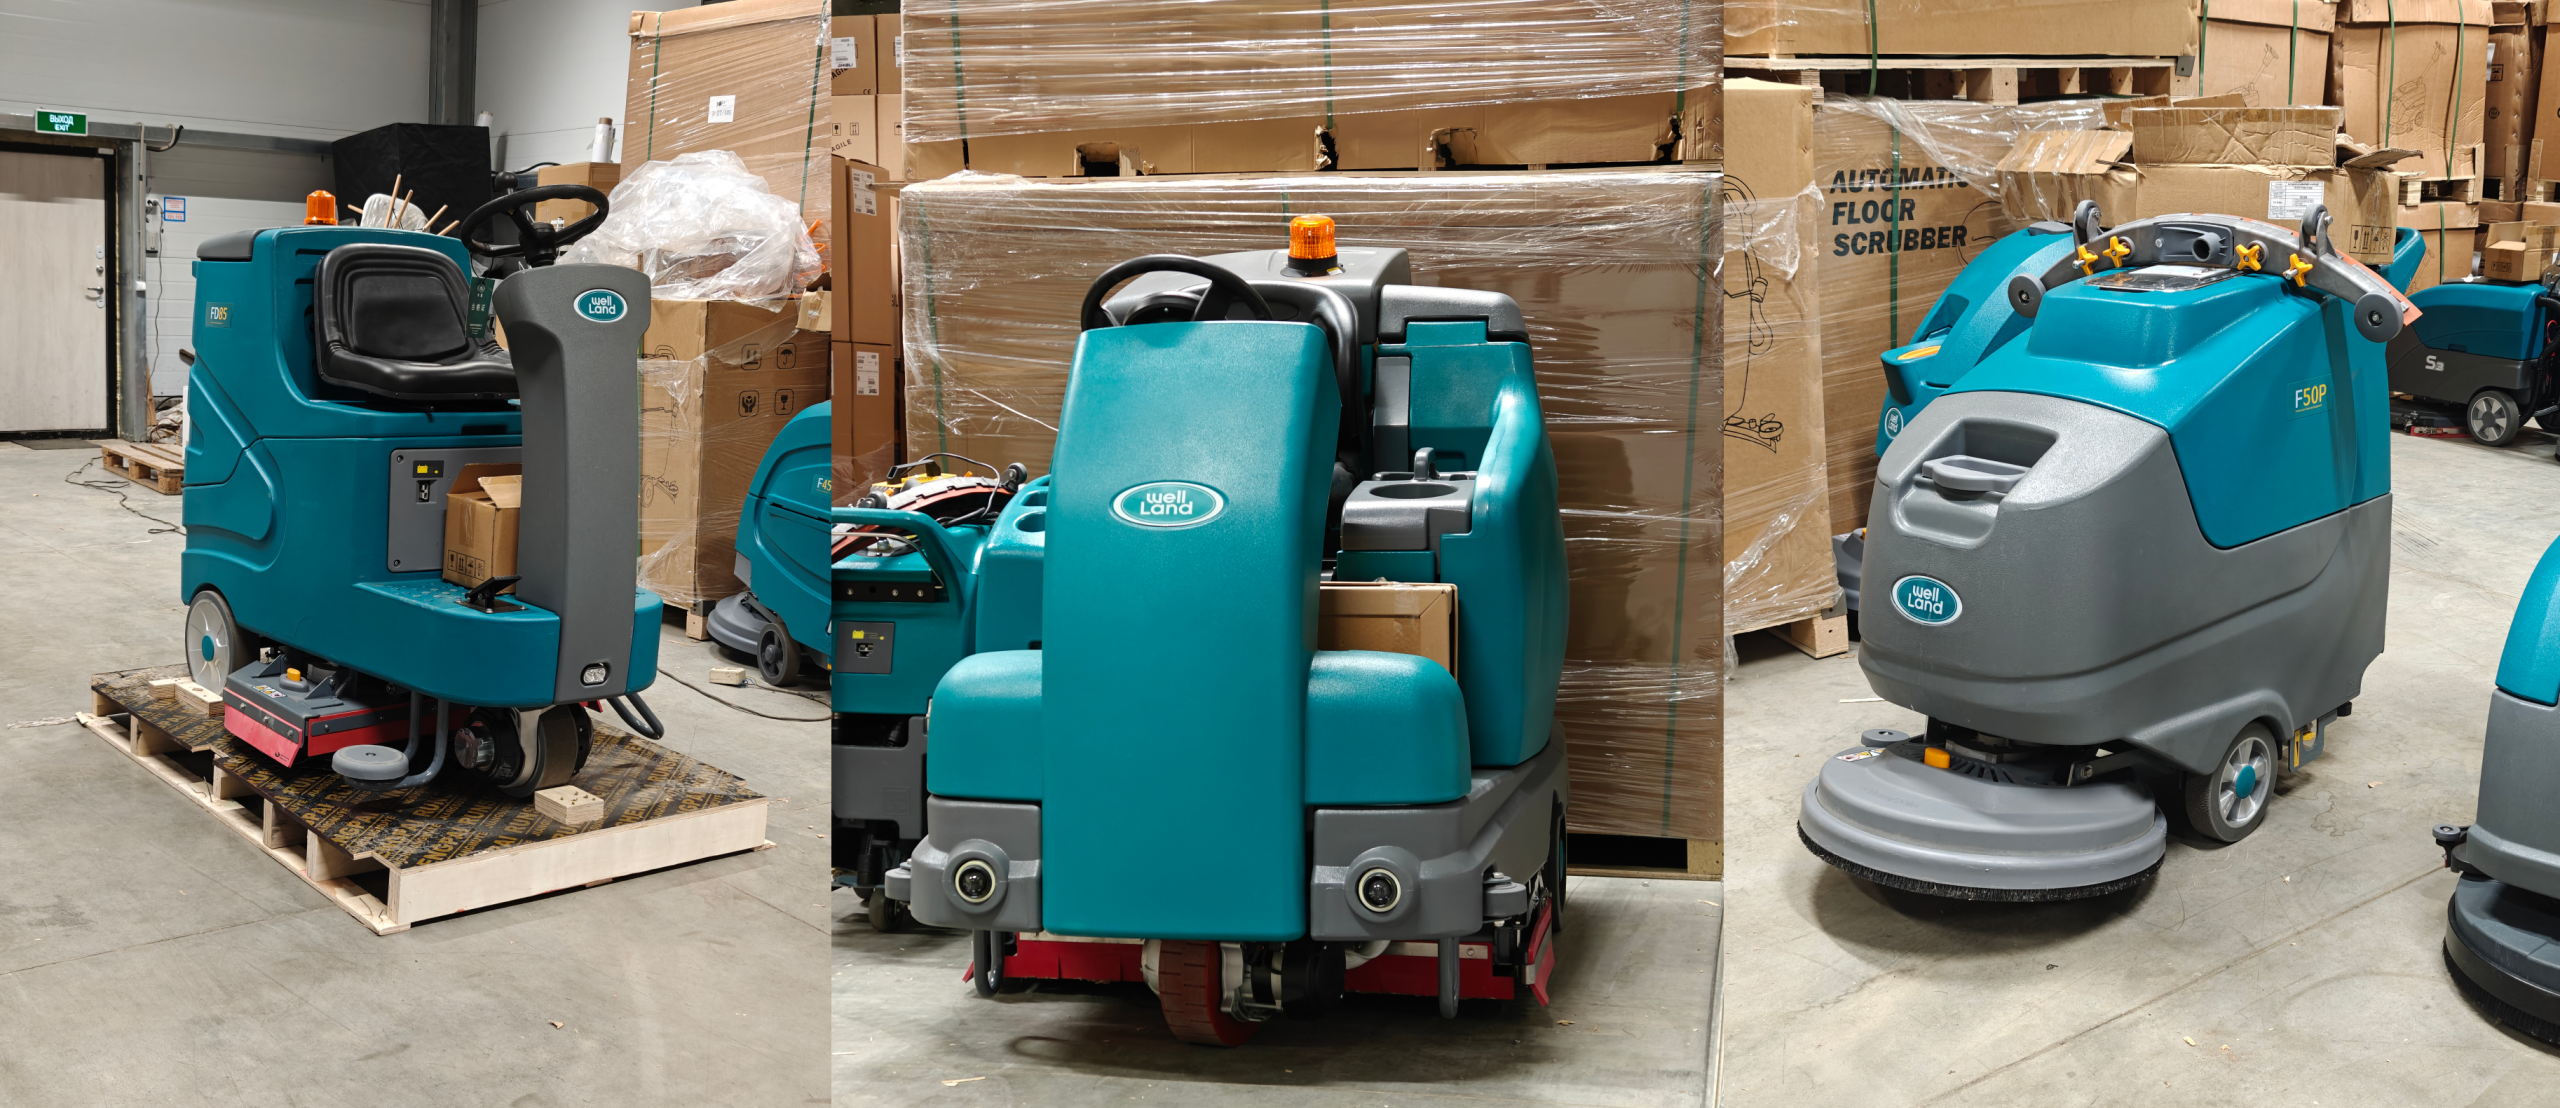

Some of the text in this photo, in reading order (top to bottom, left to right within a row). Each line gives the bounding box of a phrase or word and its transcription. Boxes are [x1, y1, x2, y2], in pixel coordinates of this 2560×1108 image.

[49, 113, 74, 126] ВЫХОД
[55, 123, 69, 131] EXIT
[1829, 166, 1969, 194] AUTOMATIC
[1832, 198, 1916, 226] FLOOR
[1833, 225, 1967, 257] SCRUBBER
[591, 295, 612, 306] well
[210, 306, 228, 321] FD85
[588, 303, 616, 315] Land
[2425, 355, 2445, 372] S3
[2295, 383, 2327, 409] F50P
[816, 477, 832, 492] F45
[1146, 489, 1187, 504] well
[1140, 500, 1193, 516] Land
[1912, 585, 1940, 602] well
[1907, 593, 1944, 615] Land
